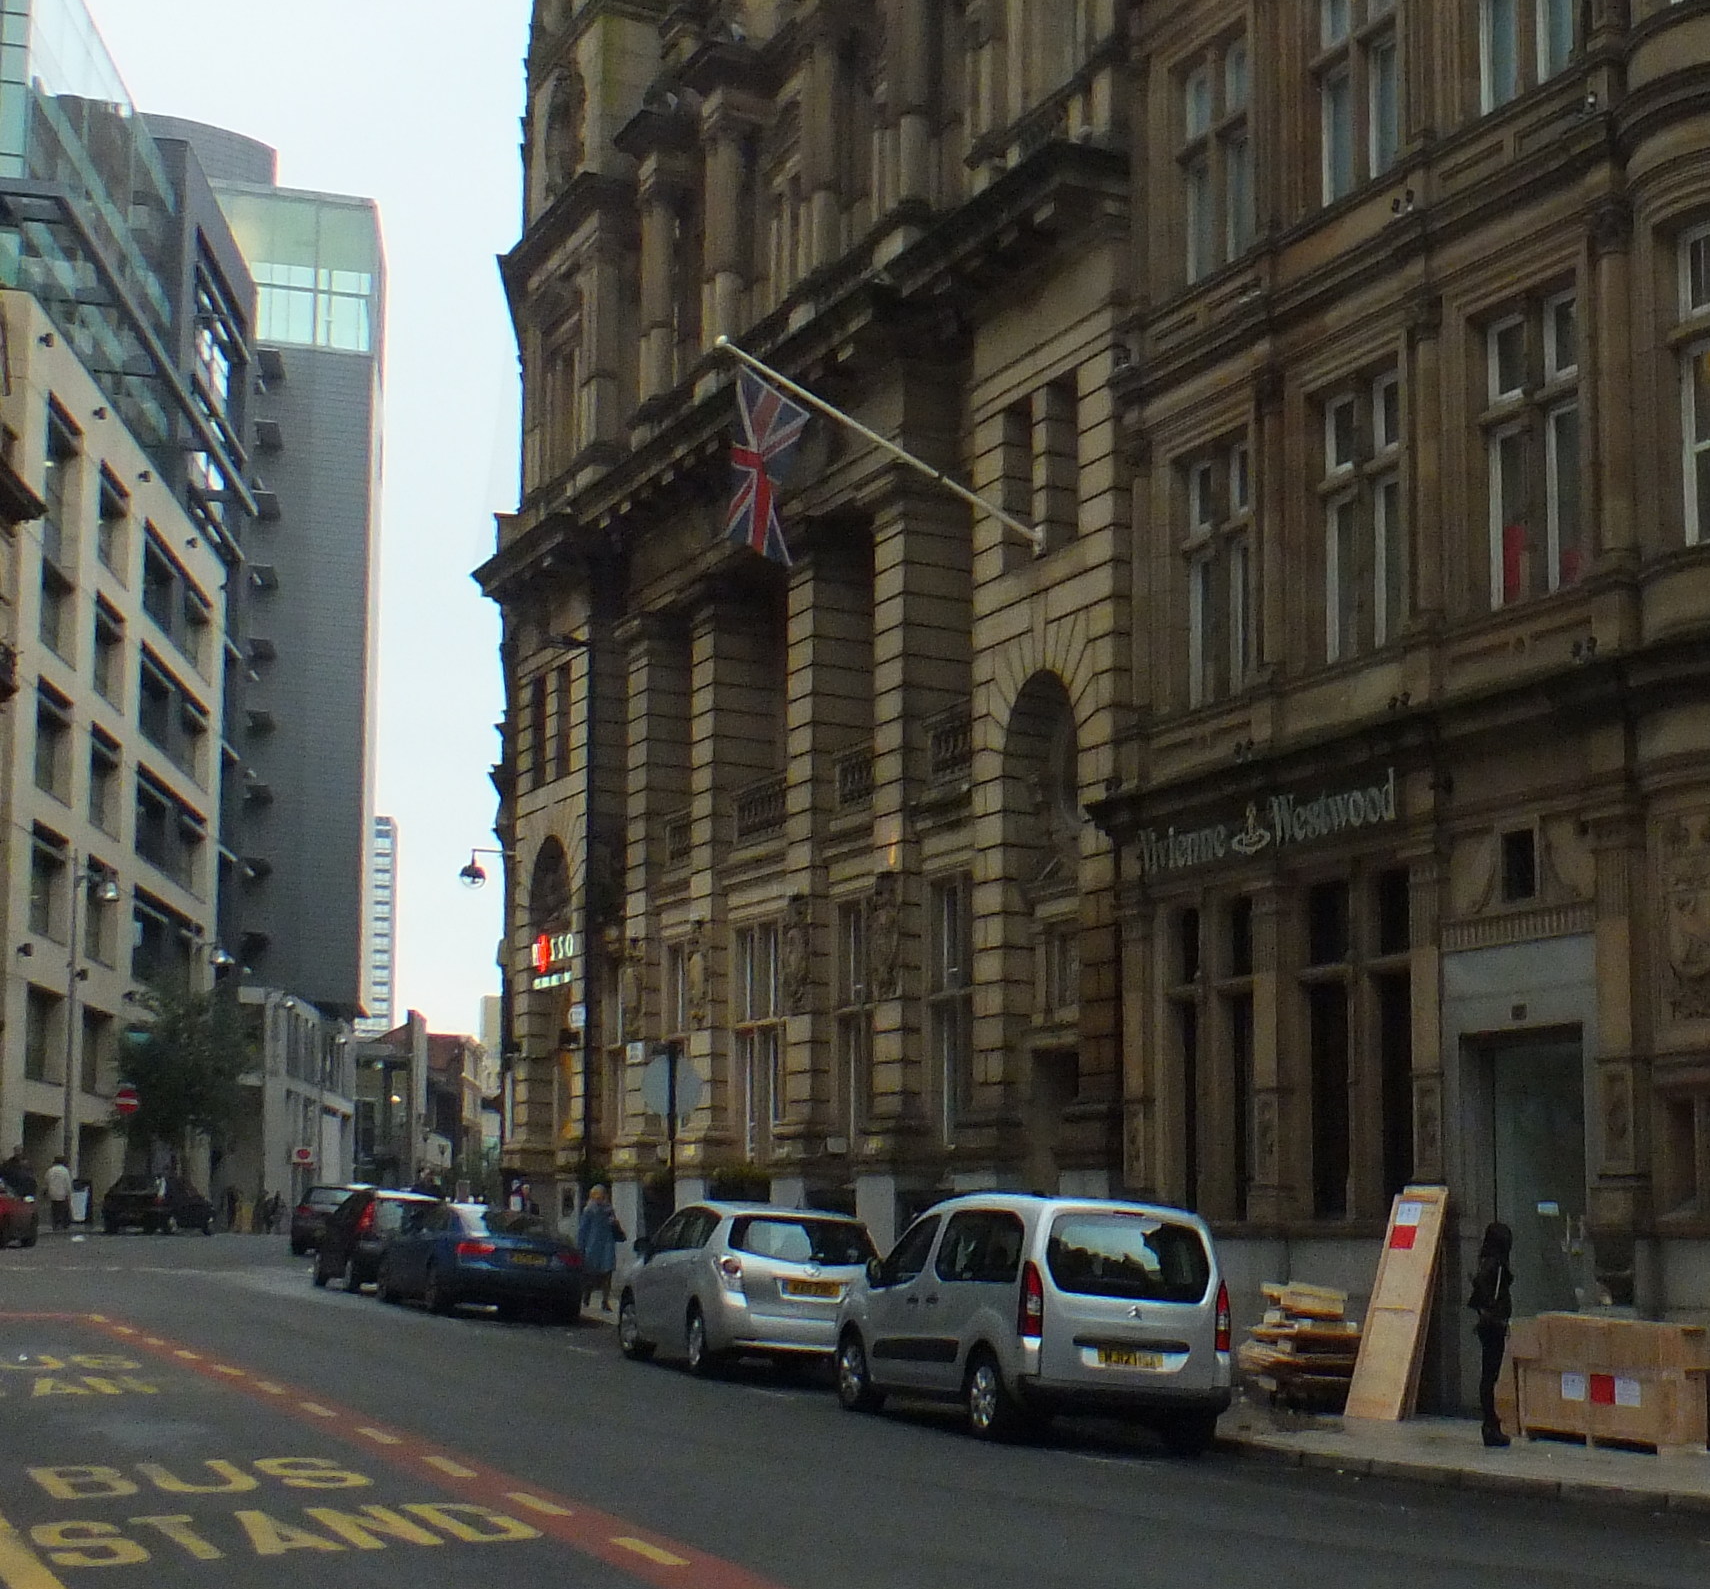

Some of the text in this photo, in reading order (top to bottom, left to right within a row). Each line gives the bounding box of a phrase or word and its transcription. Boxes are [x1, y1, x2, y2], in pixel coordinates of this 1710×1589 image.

[1269, 767, 1395, 847] Westwood
[27, 1457, 374, 1500] BUS
[29, 1502, 545, 1569] STAND
